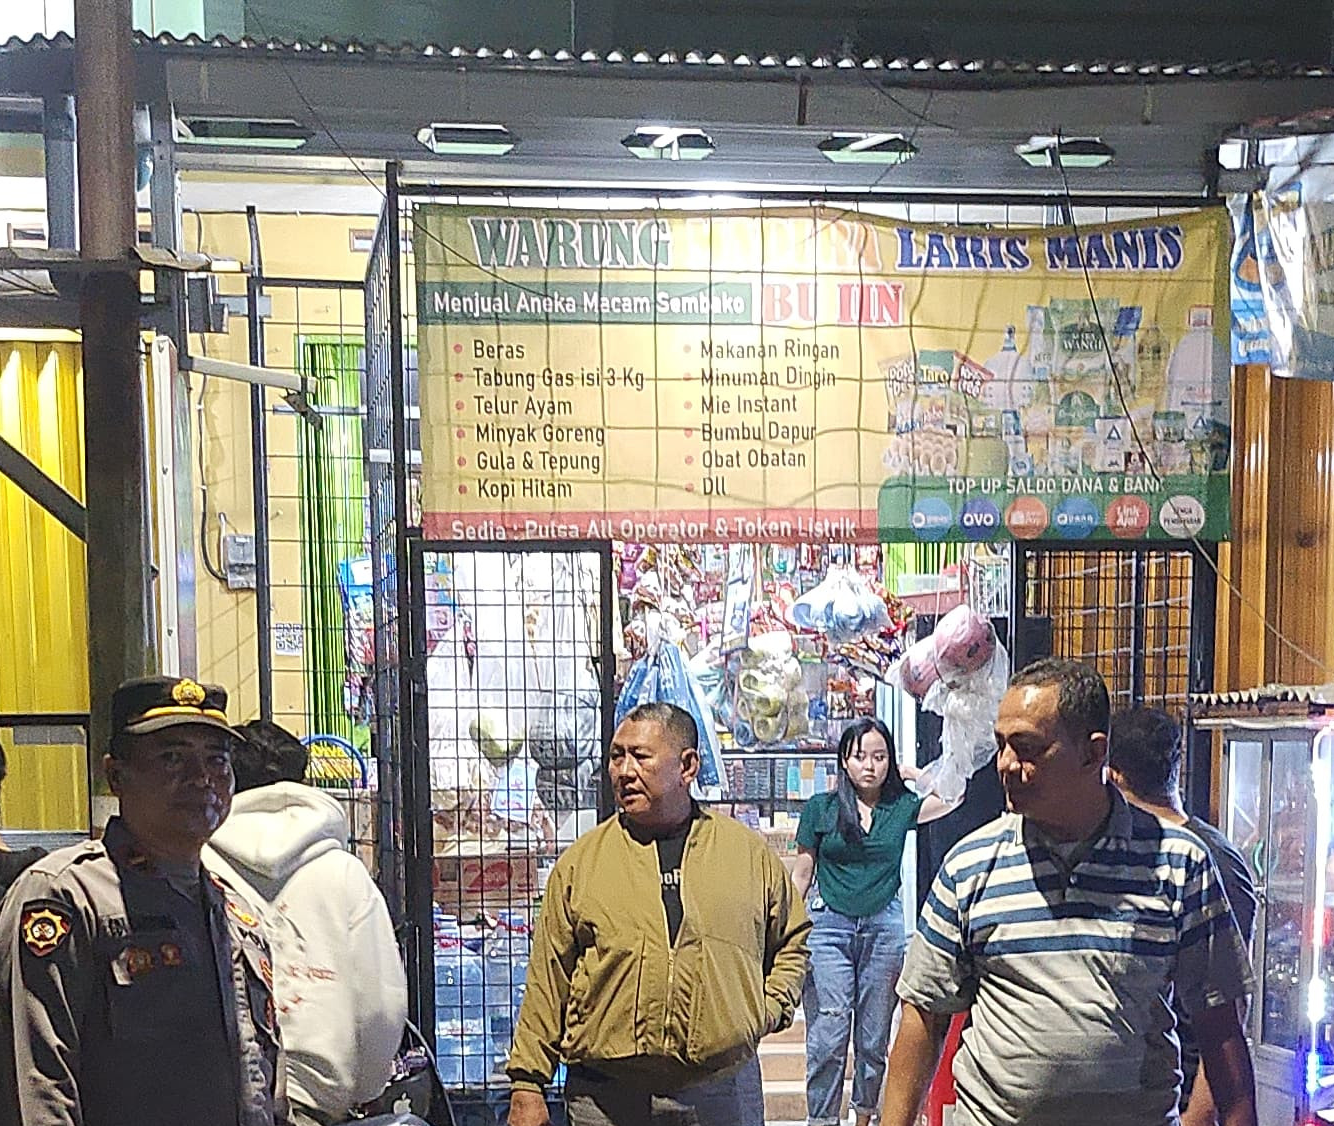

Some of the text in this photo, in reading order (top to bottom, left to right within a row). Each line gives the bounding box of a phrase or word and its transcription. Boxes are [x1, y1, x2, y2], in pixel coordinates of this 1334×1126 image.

[469, 217, 670, 268] WARUNG
[895, 225, 1033, 273] LARIS
[1044, 224, 1185, 273] MANIS
[434, 290, 746, 317] Menjual Aneka Macam Sembako
[763, 281, 818, 323] BU
[473, 340, 525, 359] Beras
[701, 338, 839, 362] Makanan Ringan
[473, 367, 644, 391] Tabung Gas isi 3 Kg
[701, 366, 836, 391] Minuman Dingin
[474, 395, 572, 420] Telur Ayam
[701, 394, 797, 414] Mie Instant
[476, 424, 605, 447] Minyak Goreng
[702, 421, 816, 445] Bumbu Dapur
[477, 451, 600, 474] Gula & Tepung
[702, 448, 806, 469] Obat Obatan
[478, 478, 572, 503] Kopi Hitam
[703, 476, 726, 496] Dll
[947, 476, 1167, 495] TOP UP SALDO DANA & BANK
[452, 519, 506, 541] Sedia
[587, 519, 613, 540] All
[620, 518, 709, 541] Operator
[715, 518, 730, 539] &
[734, 516, 792, 538] Token
[798, 515, 857, 538] Listrik
